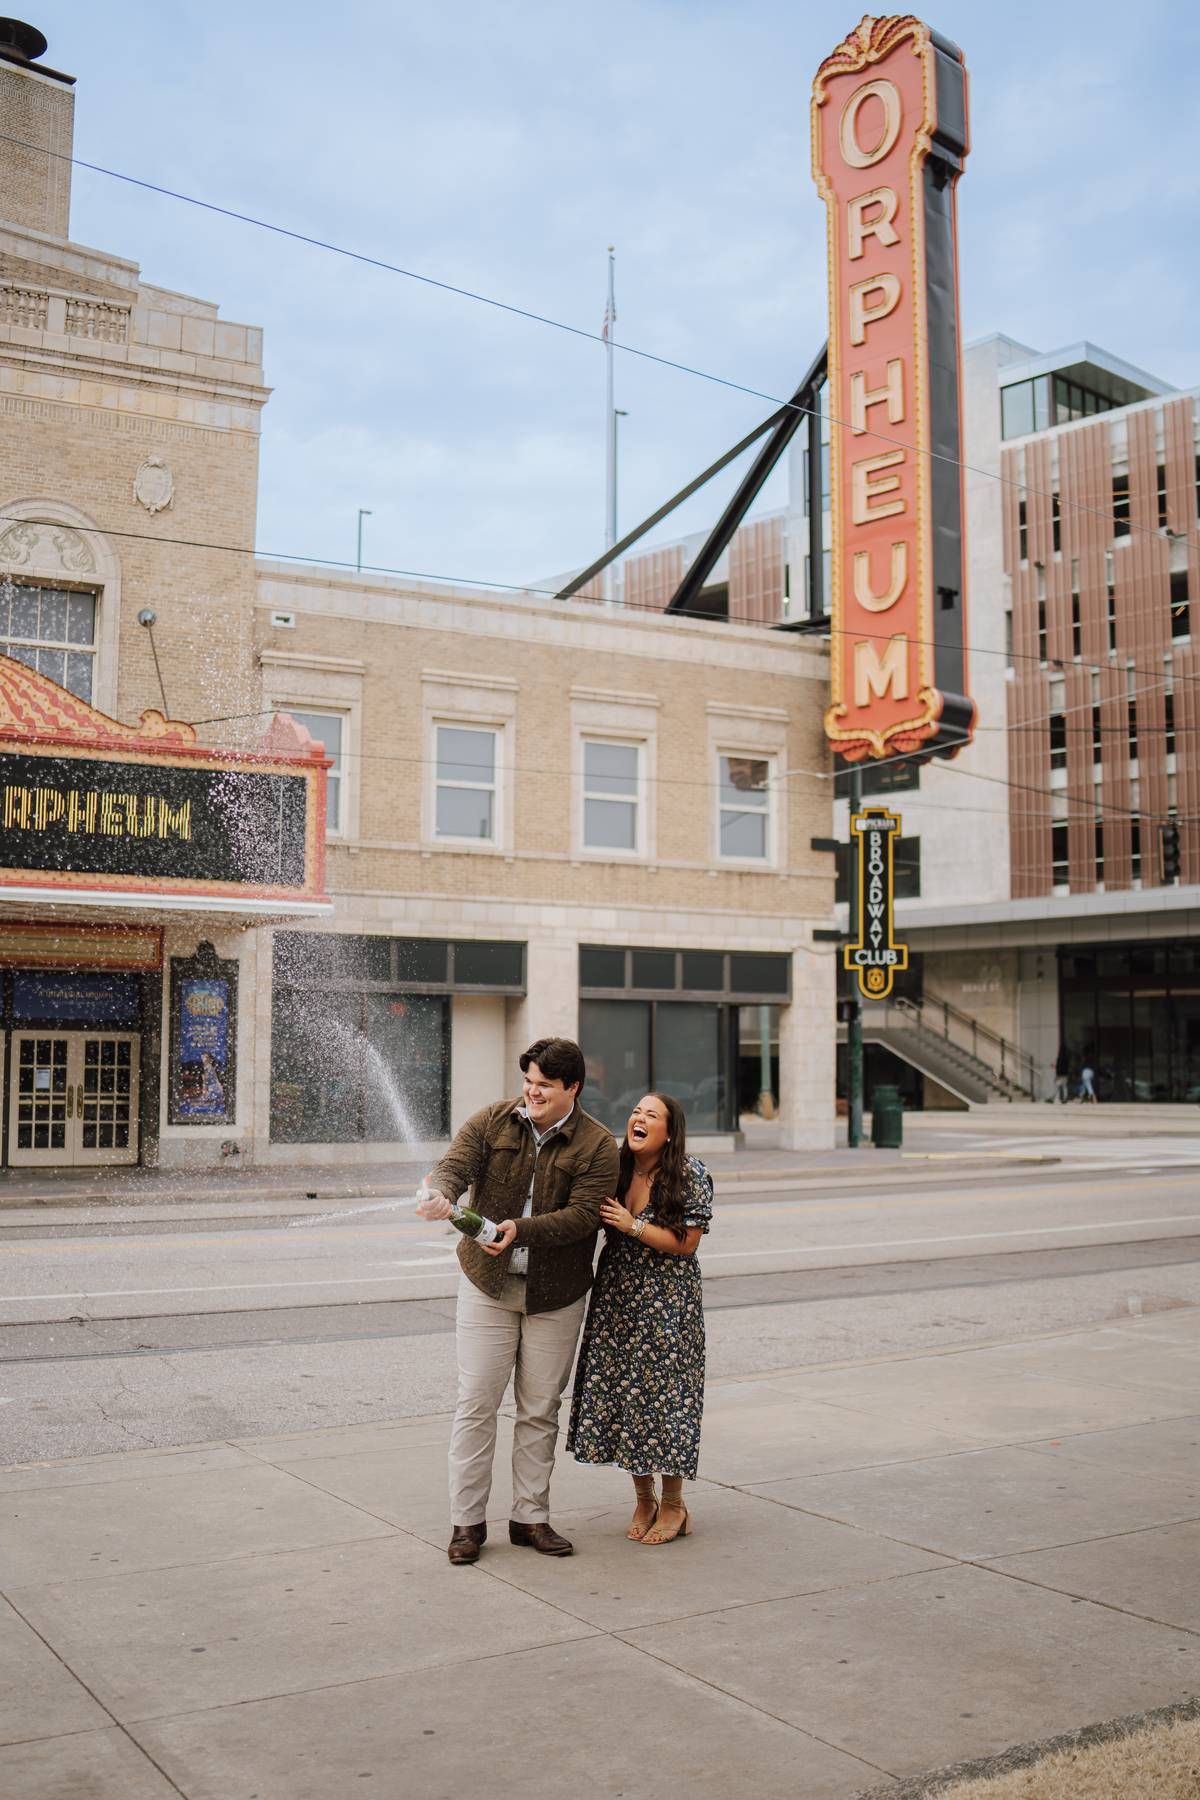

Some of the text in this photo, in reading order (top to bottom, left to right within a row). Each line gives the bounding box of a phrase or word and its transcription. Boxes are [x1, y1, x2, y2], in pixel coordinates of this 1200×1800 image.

[839, 78, 909, 708] ORPHEUM
[867, 831, 885, 948] BROADWAY
[854, 949, 898, 966] CLUB
